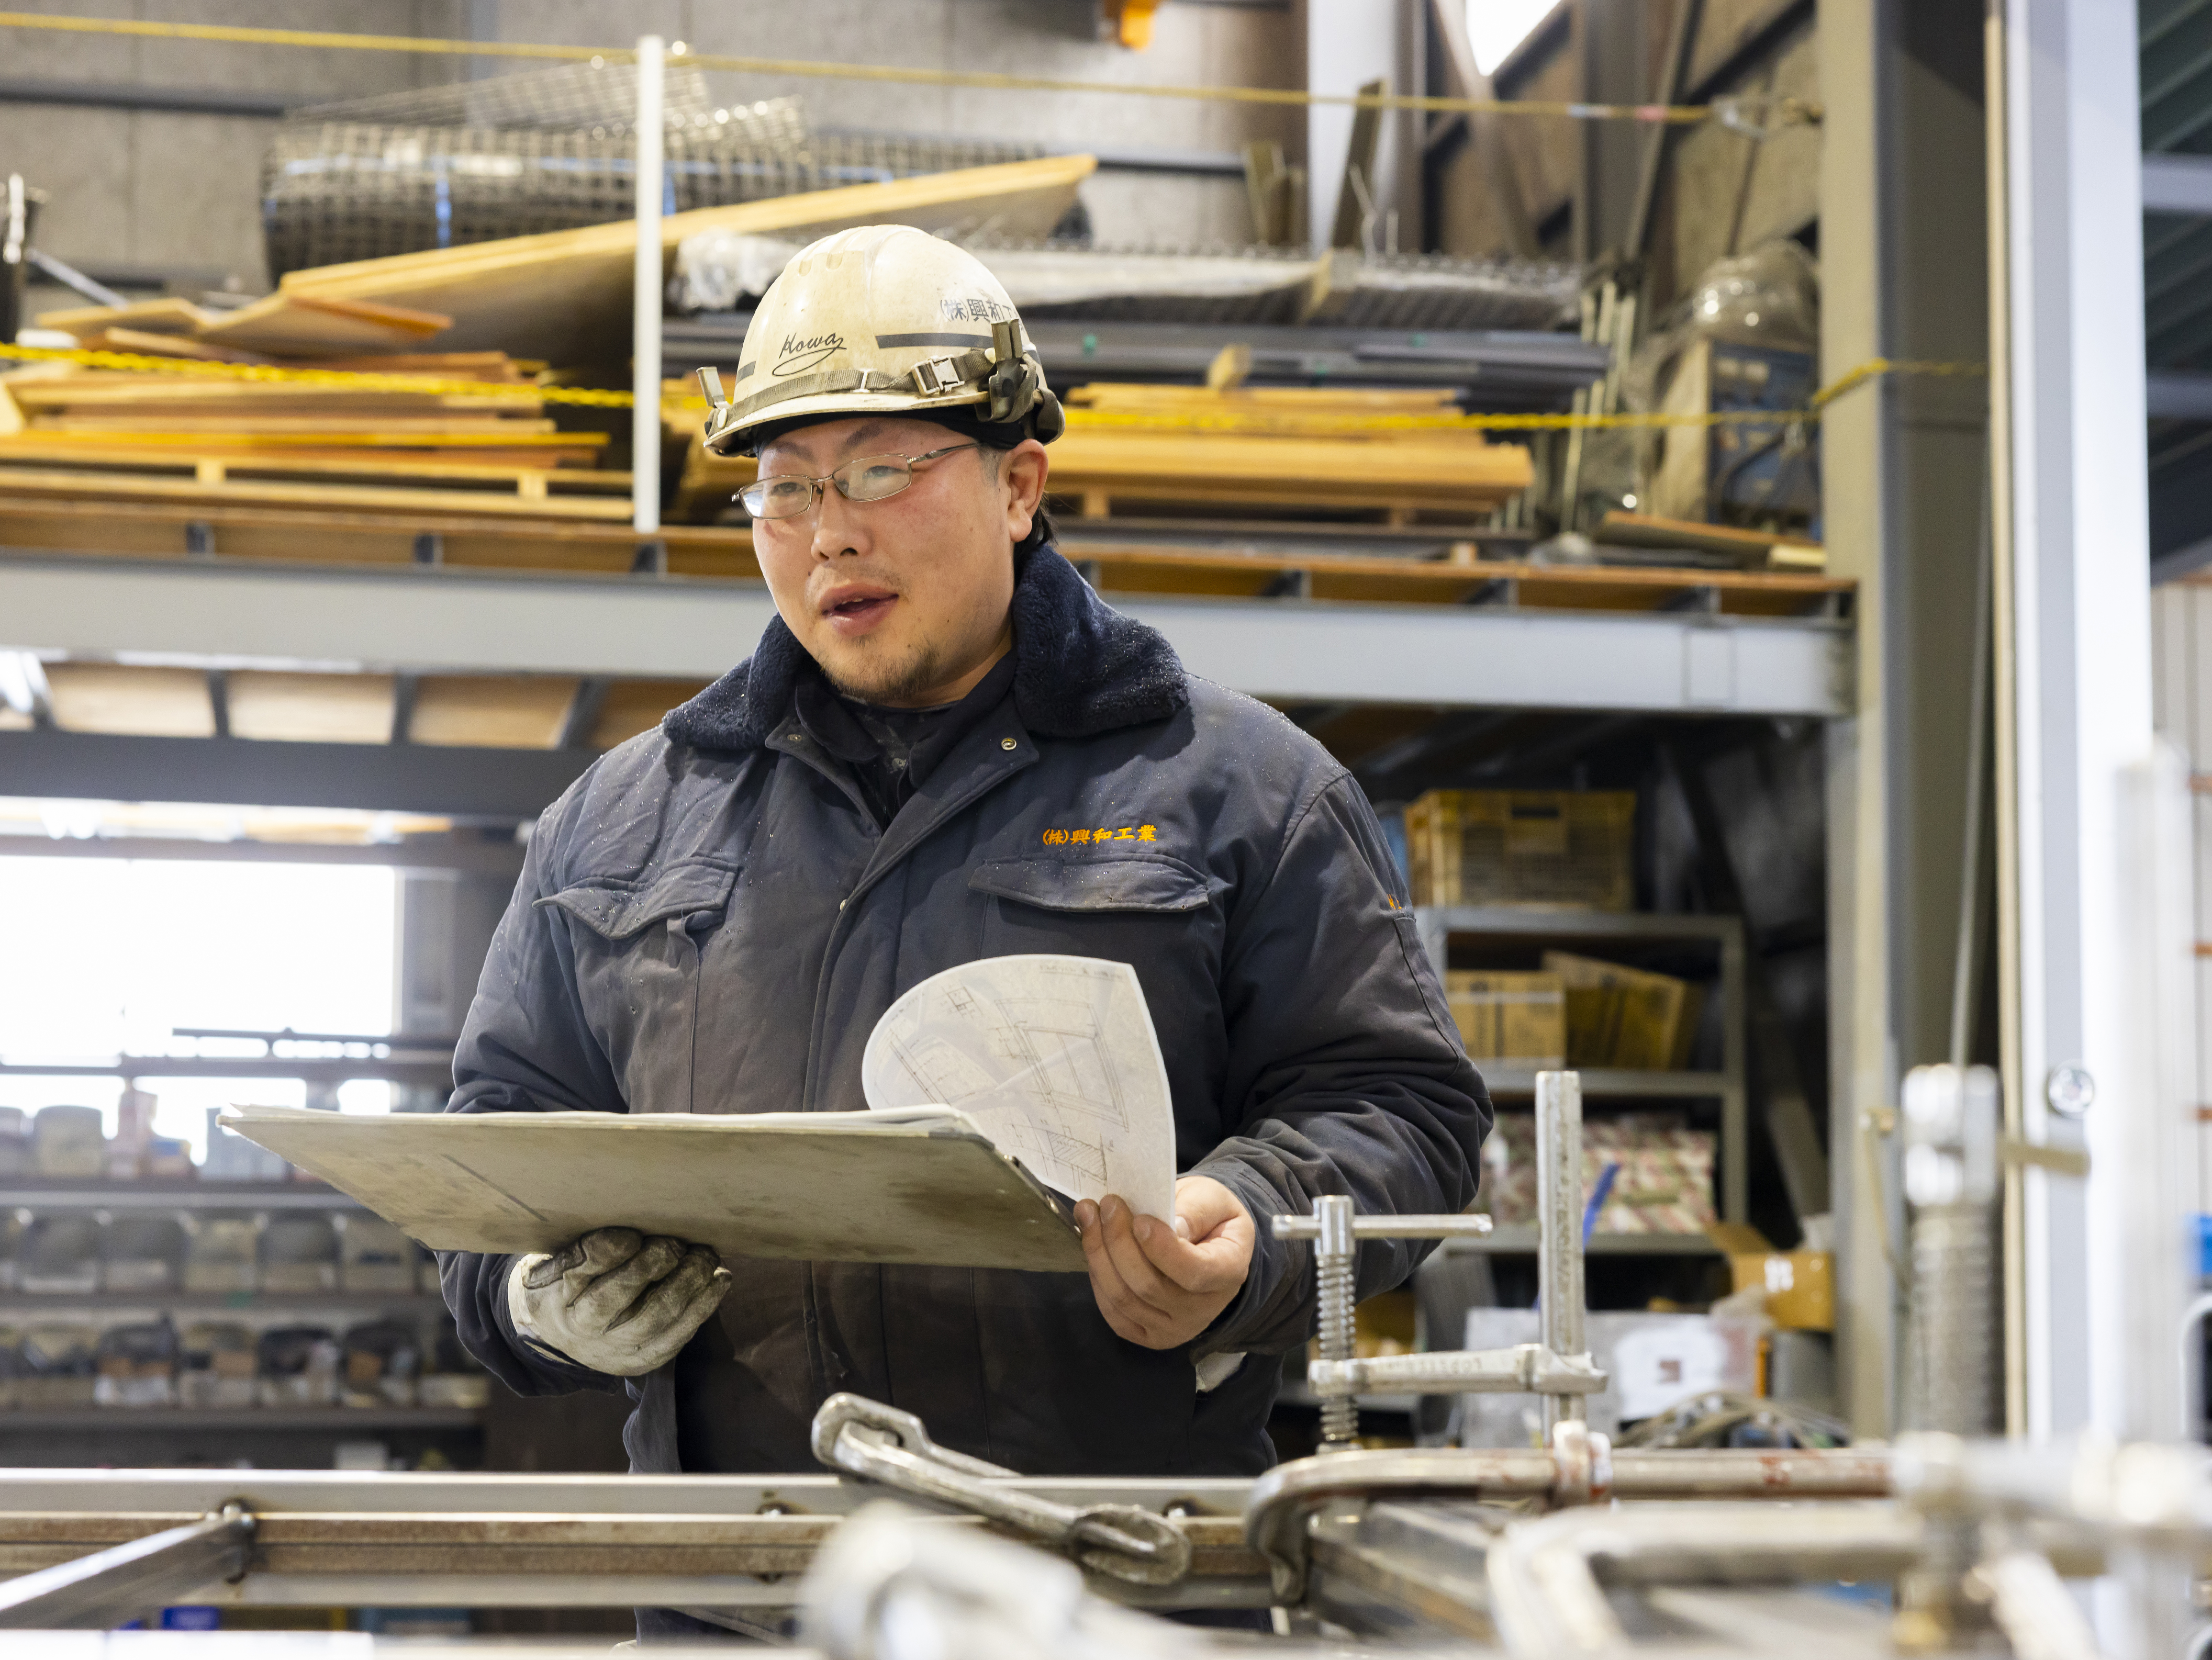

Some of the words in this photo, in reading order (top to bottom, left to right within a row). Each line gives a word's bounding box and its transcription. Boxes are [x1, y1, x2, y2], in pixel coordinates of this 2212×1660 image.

[1043, 824, 1157, 846] (株)興和工業
